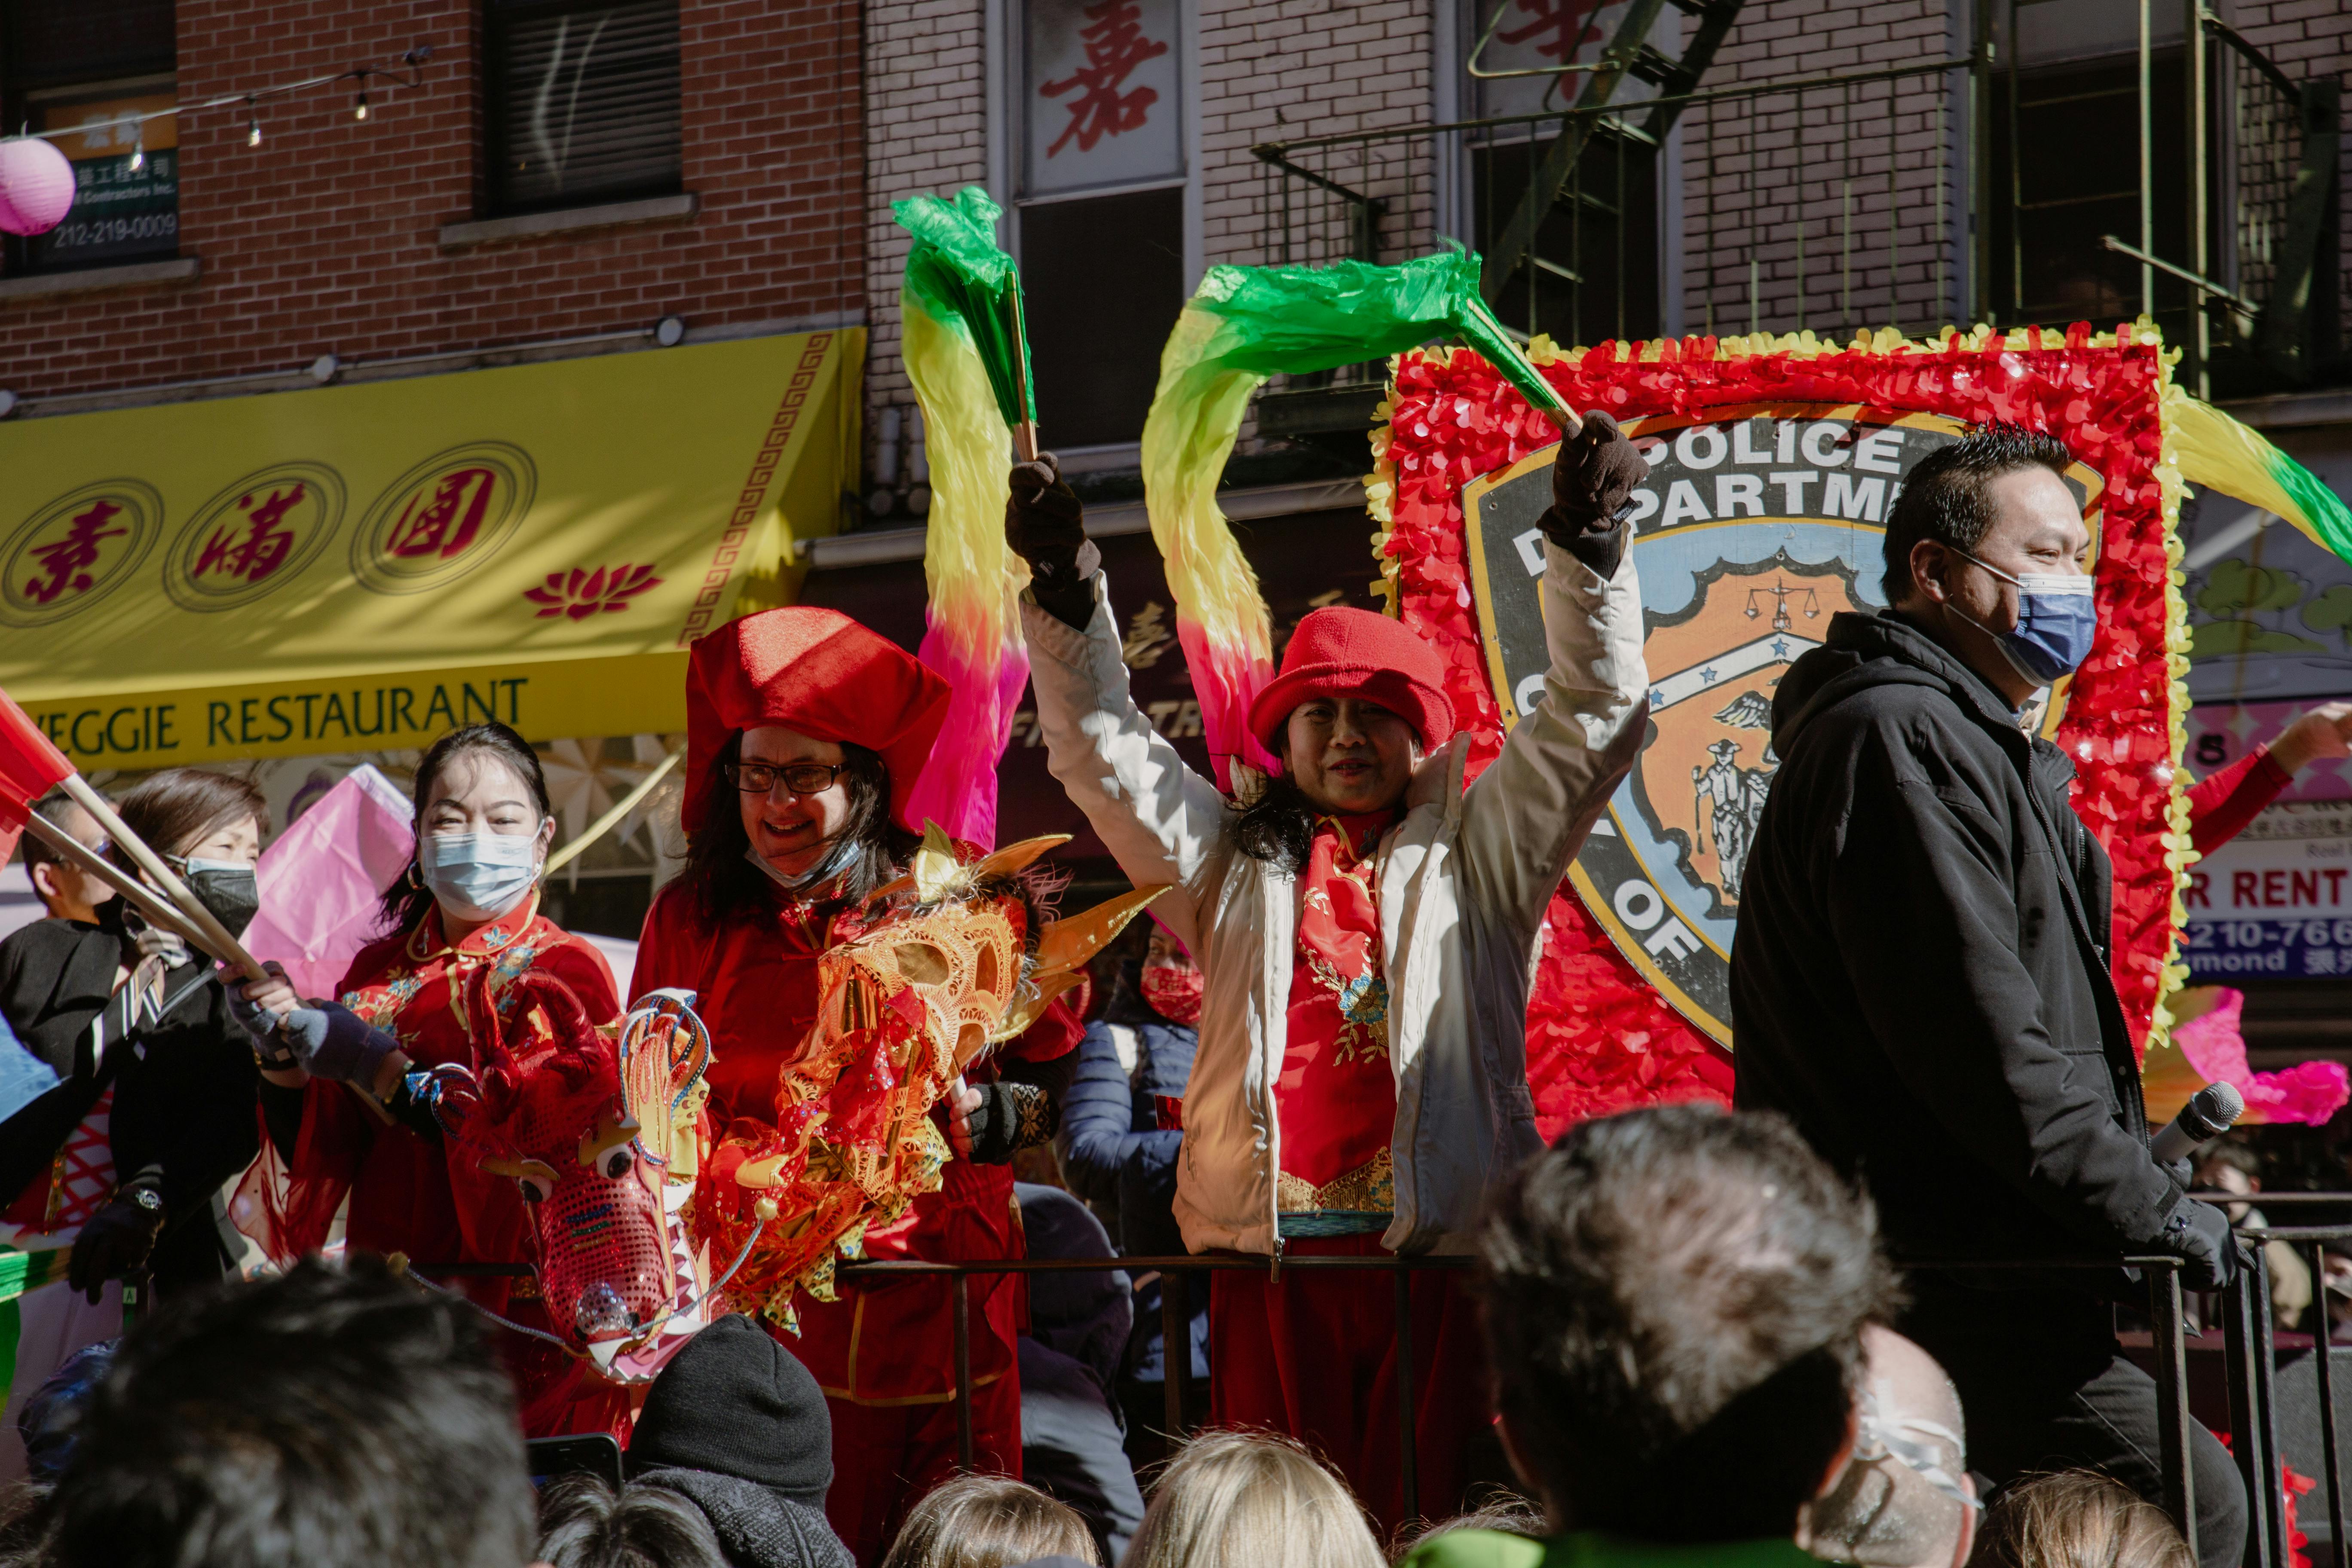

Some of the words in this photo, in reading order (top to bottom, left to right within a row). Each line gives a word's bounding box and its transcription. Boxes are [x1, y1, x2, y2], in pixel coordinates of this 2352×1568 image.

[54, 213, 176, 248] 212-219-0009
[1629, 420, 1905, 475] POLICE
[1512, 470, 1902, 577] DPARTM
[37, 705, 180, 756] EGGIE
[207, 678, 528, 747] RESTAURANT
[2233, 869, 2349, 909] RENT
[1614, 879, 1703, 961] OF
[2188, 921, 2352, 948] 210-766
[2182, 947, 2287, 973] mond
